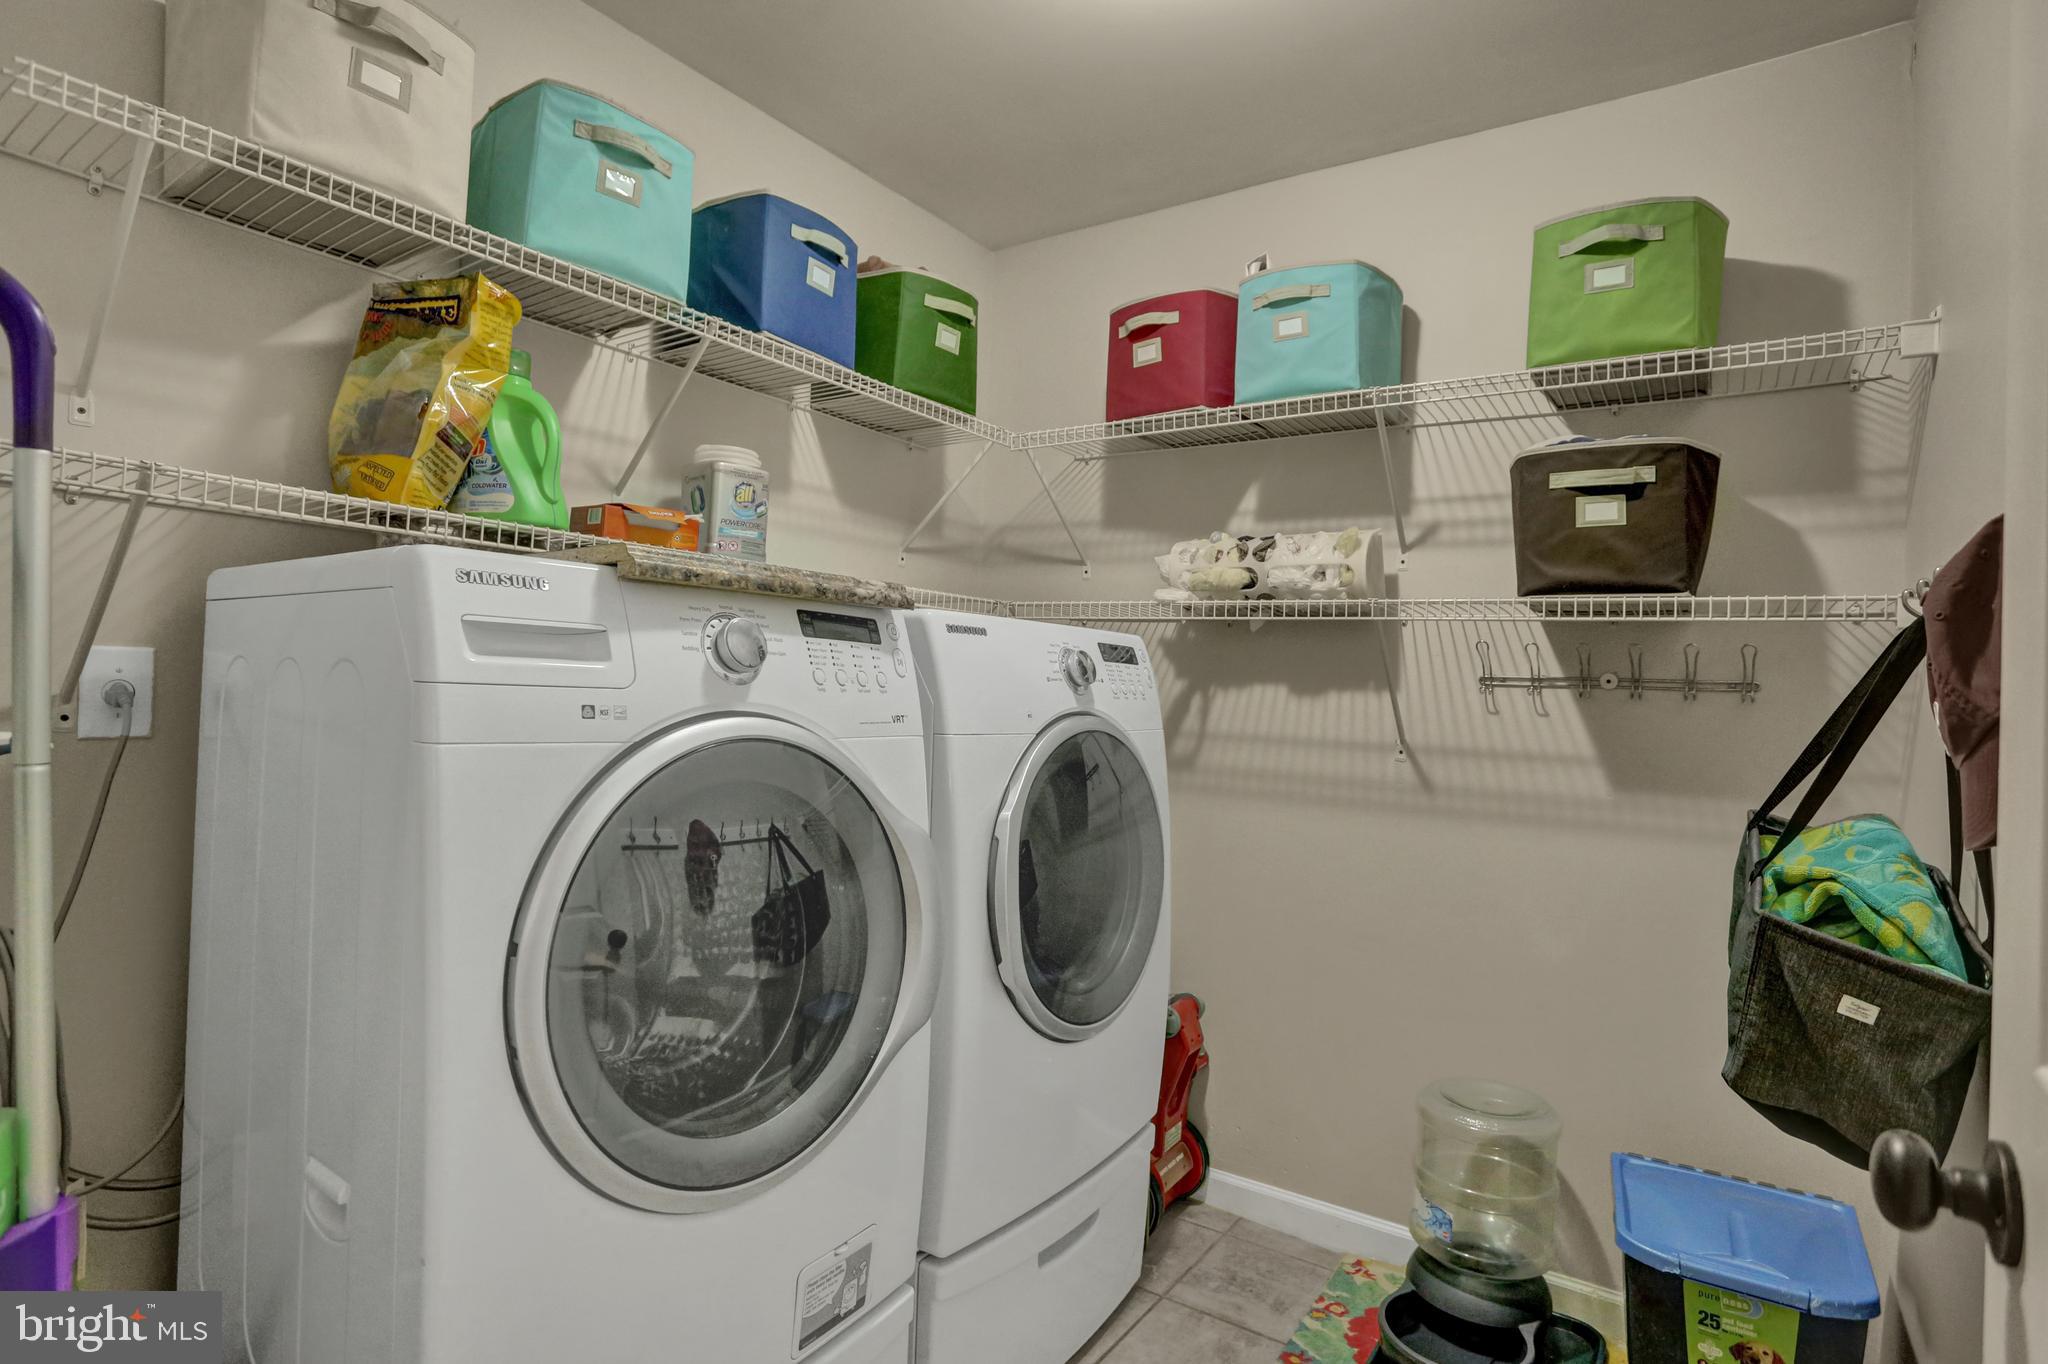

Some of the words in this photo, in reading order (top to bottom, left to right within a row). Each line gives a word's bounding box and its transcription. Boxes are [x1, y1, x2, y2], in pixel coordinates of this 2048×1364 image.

[734, 485, 754, 503] all
[720, 518, 761, 530] POWERCORE
[455, 567, 550, 592] SAMSUNG
[945, 623, 988, 637] SAMSUNG
[891, 714, 905, 724] VRT
[1698, 1290, 1721, 1302] pure
[1697, 1309, 1721, 1331] 25
